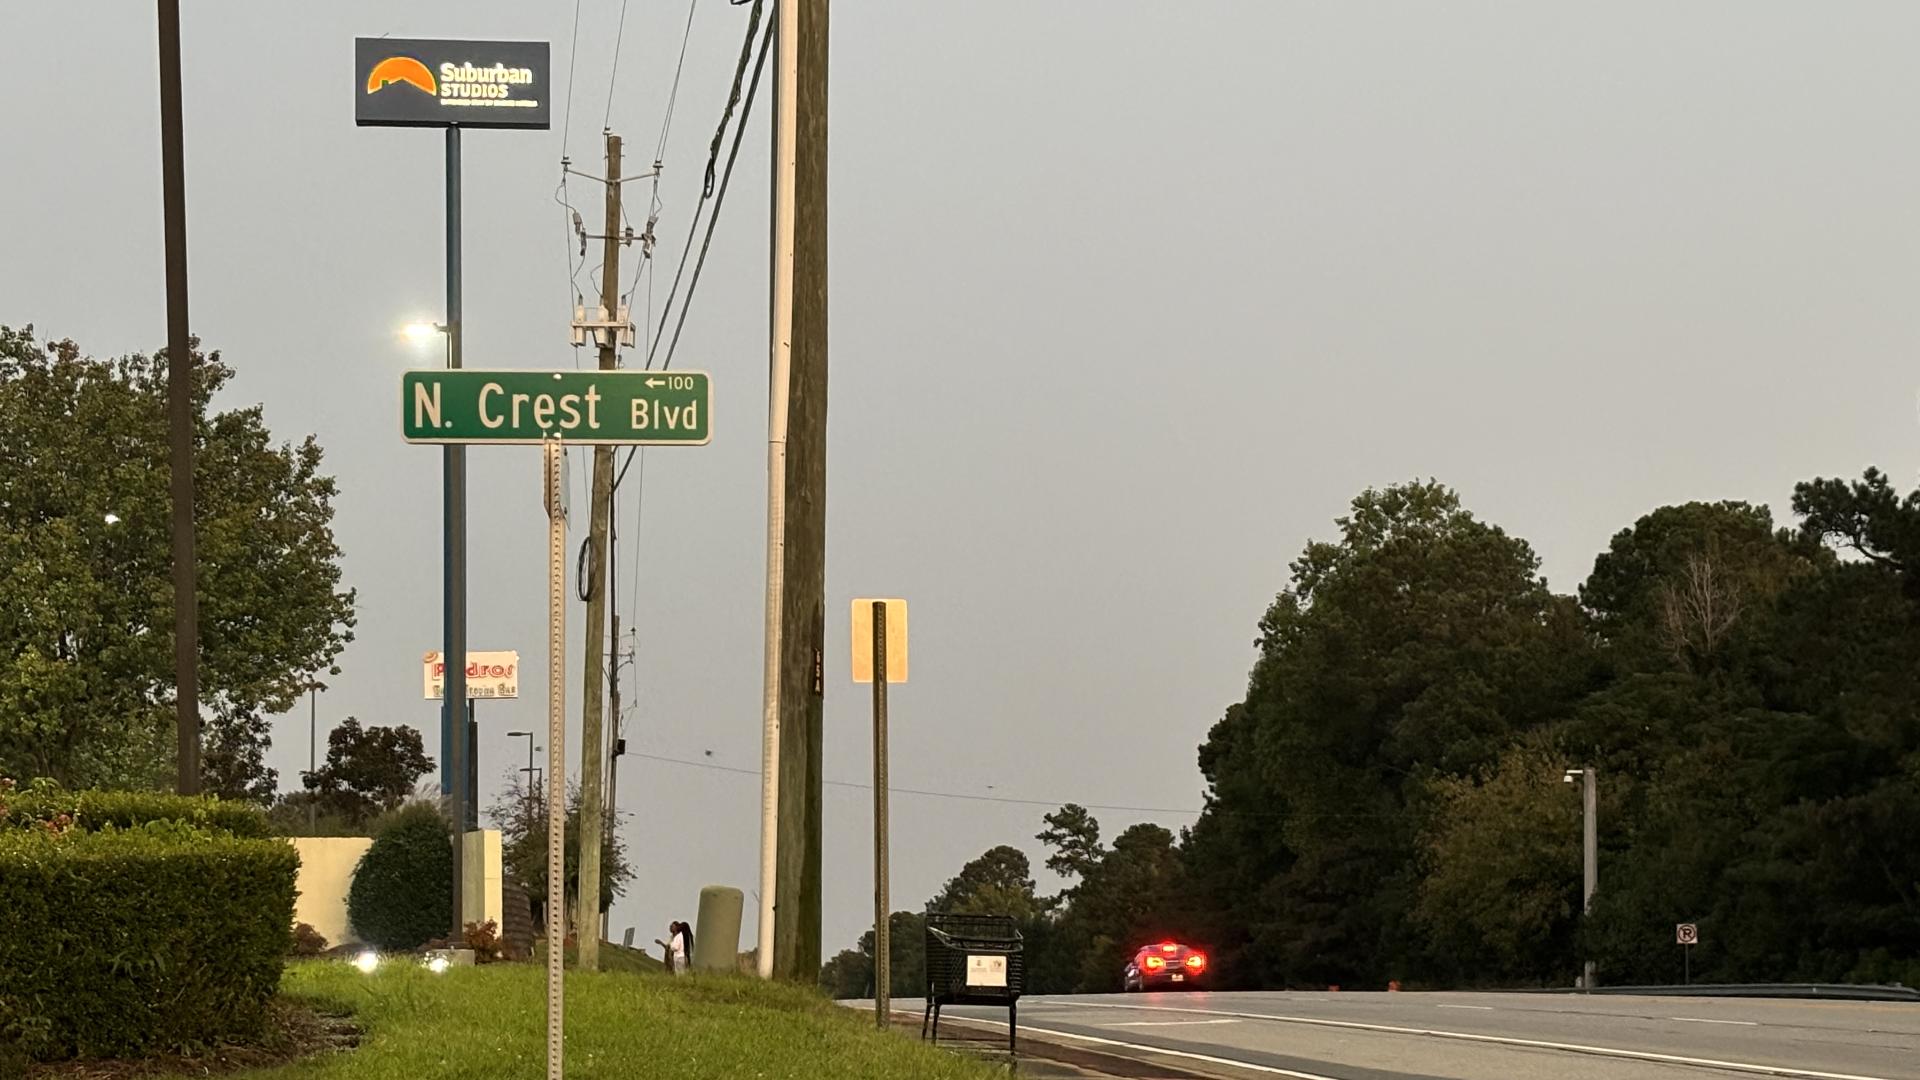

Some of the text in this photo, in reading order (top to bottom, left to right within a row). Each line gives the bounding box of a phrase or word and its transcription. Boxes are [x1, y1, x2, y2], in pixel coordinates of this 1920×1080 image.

[440, 61, 533, 84] Suburban
[440, 83, 509, 98] STUDIOS
[667, 376, 694, 390] 100
[414, 381, 698, 430] N. Crest Blvd
